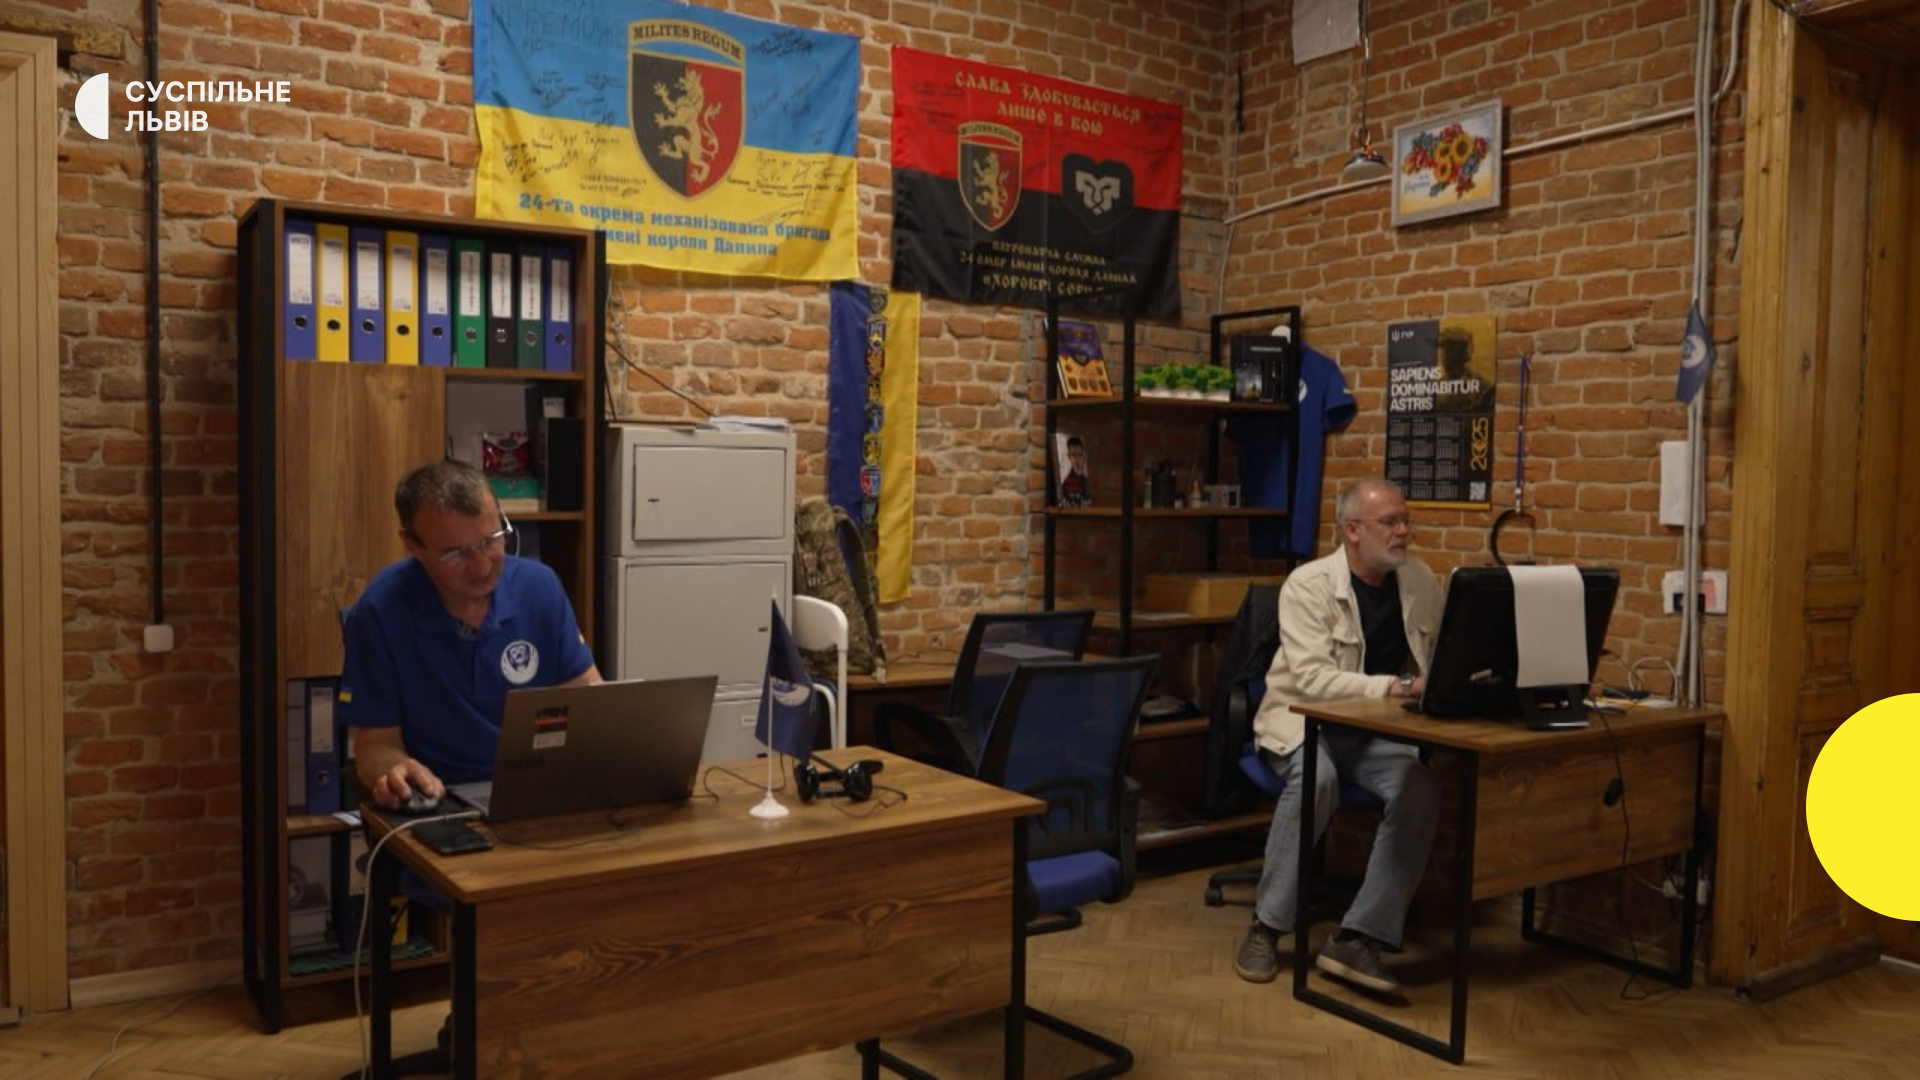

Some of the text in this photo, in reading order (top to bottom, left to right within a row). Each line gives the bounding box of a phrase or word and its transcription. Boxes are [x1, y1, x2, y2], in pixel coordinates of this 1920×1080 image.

[634, 24, 690, 40] MILITES
[693, 27, 741, 60] REGUM
[955, 71, 1011, 95] СЛАВА
[1054, 112, 1063, 127] В
[1071, 116, 1103, 136] БОЮ
[519, 192, 574, 213] 24-та
[580, 205, 645, 223] окрема
[651, 212, 768, 237] механізована
[648, 233, 707, 250] короля
[714, 236, 778, 257] Данила
[1391, 367, 1441, 382] SAPIENS
[1391, 379, 1480, 397] DOMINABITUR
[1390, 397, 1433, 412] ASTRIS
